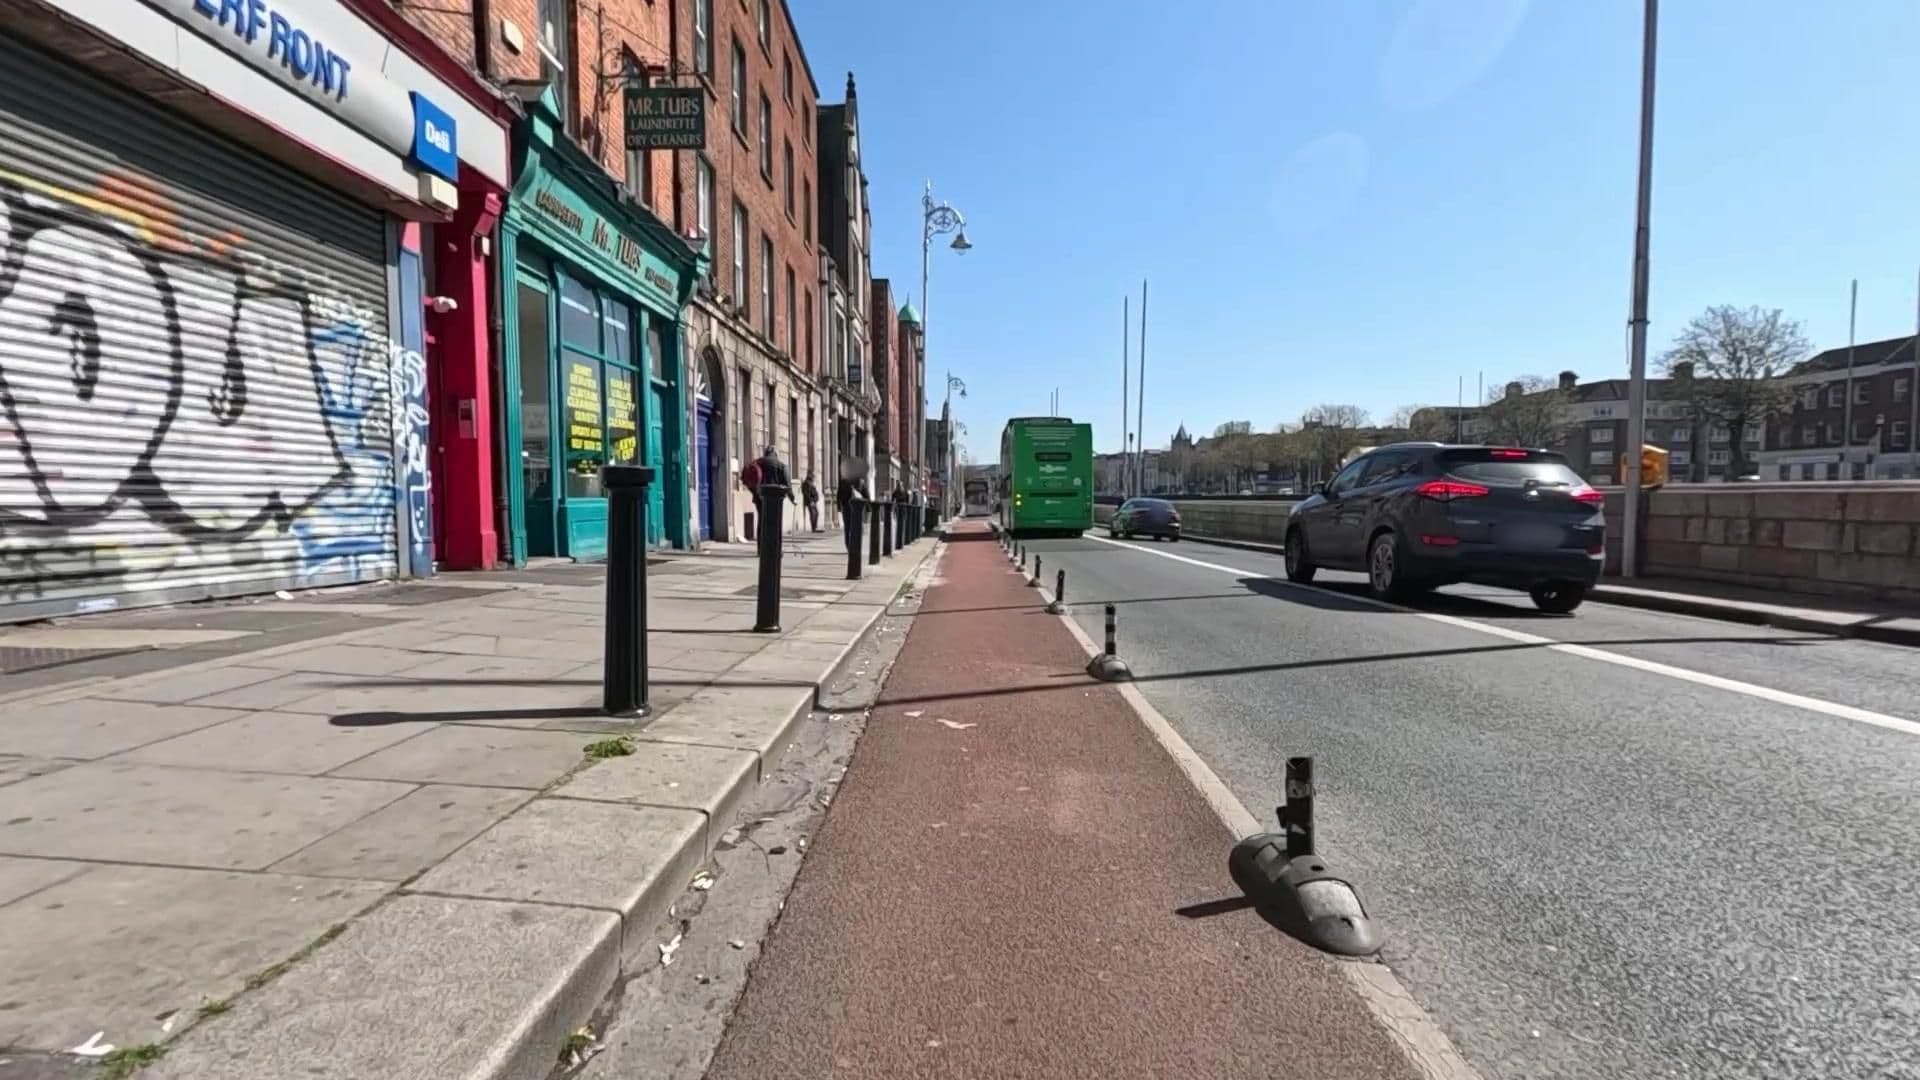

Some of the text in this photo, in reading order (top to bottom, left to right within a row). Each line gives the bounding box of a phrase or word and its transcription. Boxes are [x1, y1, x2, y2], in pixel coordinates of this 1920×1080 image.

[630, 117, 697, 130] LAUNDRETTE
[424, 119, 451, 154] Deli
[627, 132, 702, 146] DRY CLEANERS
